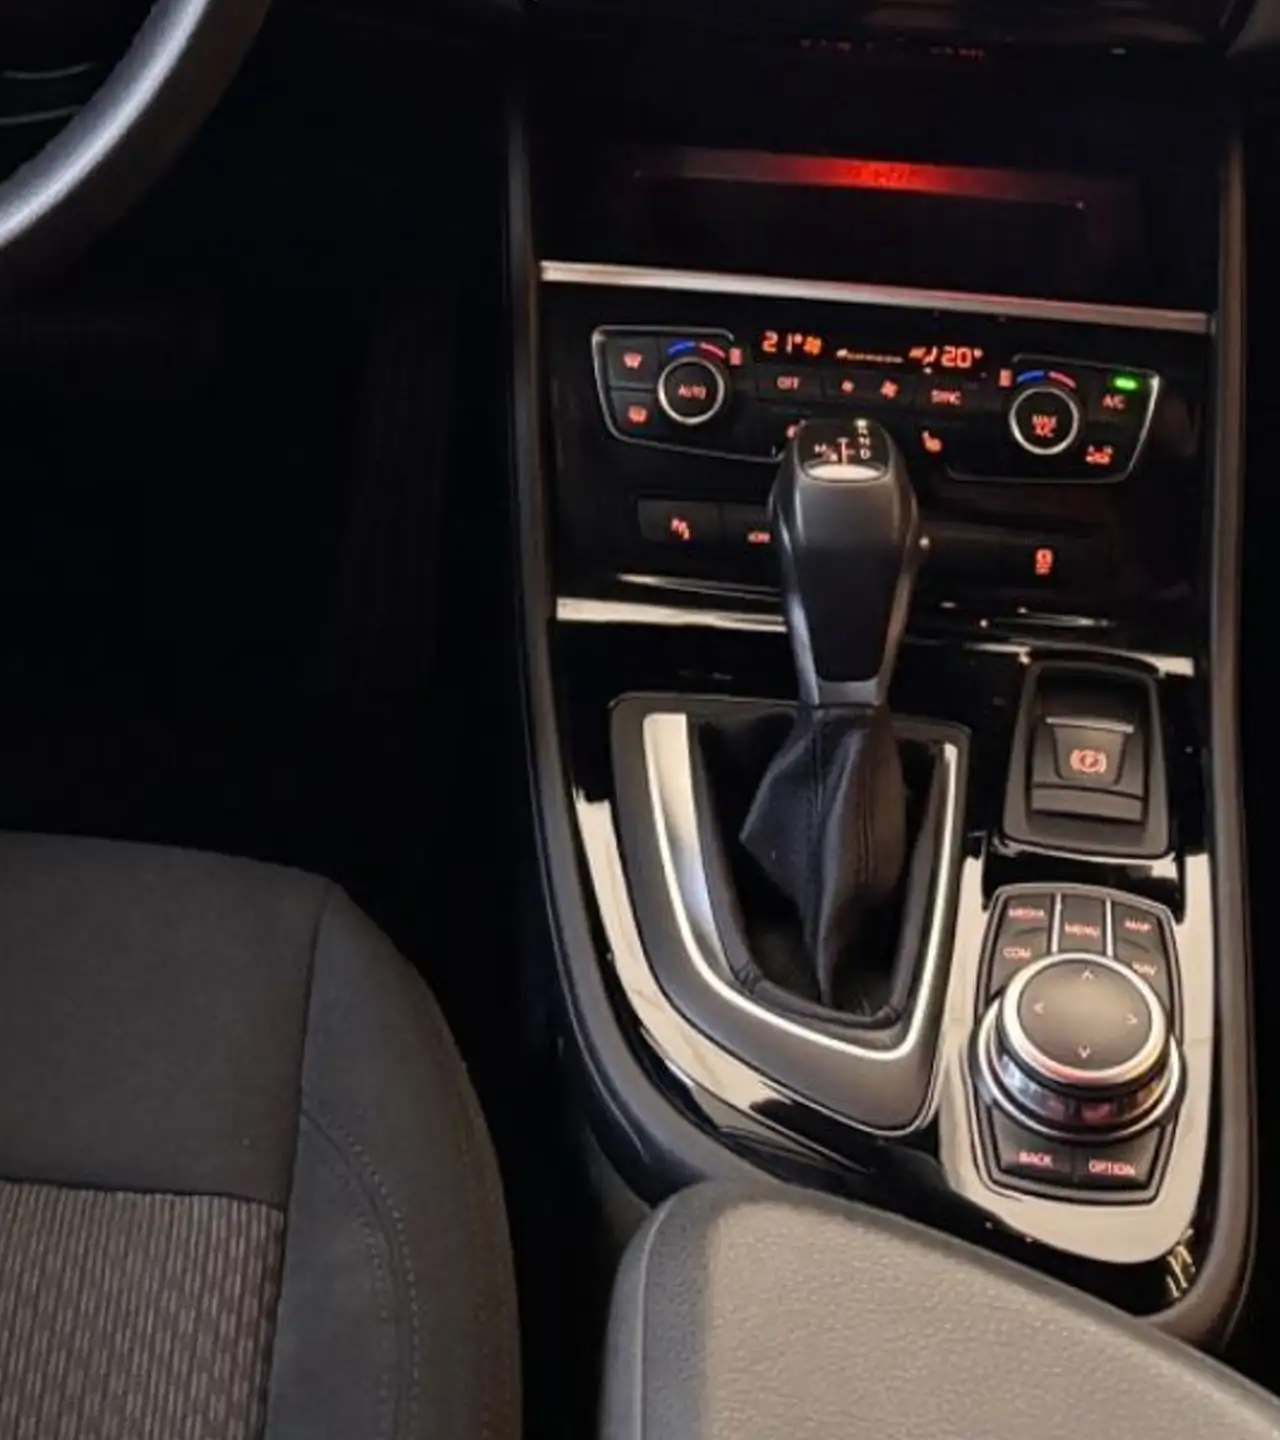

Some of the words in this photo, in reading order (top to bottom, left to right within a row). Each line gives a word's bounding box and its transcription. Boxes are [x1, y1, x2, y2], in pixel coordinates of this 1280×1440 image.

[777, 376, 801, 389] OFF
[678, 384, 706, 399] AUTO
[1102, 395, 1125, 409] A/C
[1064, 921, 1099, 938] MENU
[1124, 917, 1152, 932] MAP
[1002, 947, 1032, 960] COM
[1018, 1151, 1053, 1167] BACK
[1088, 1158, 1136, 1176] OPTION
